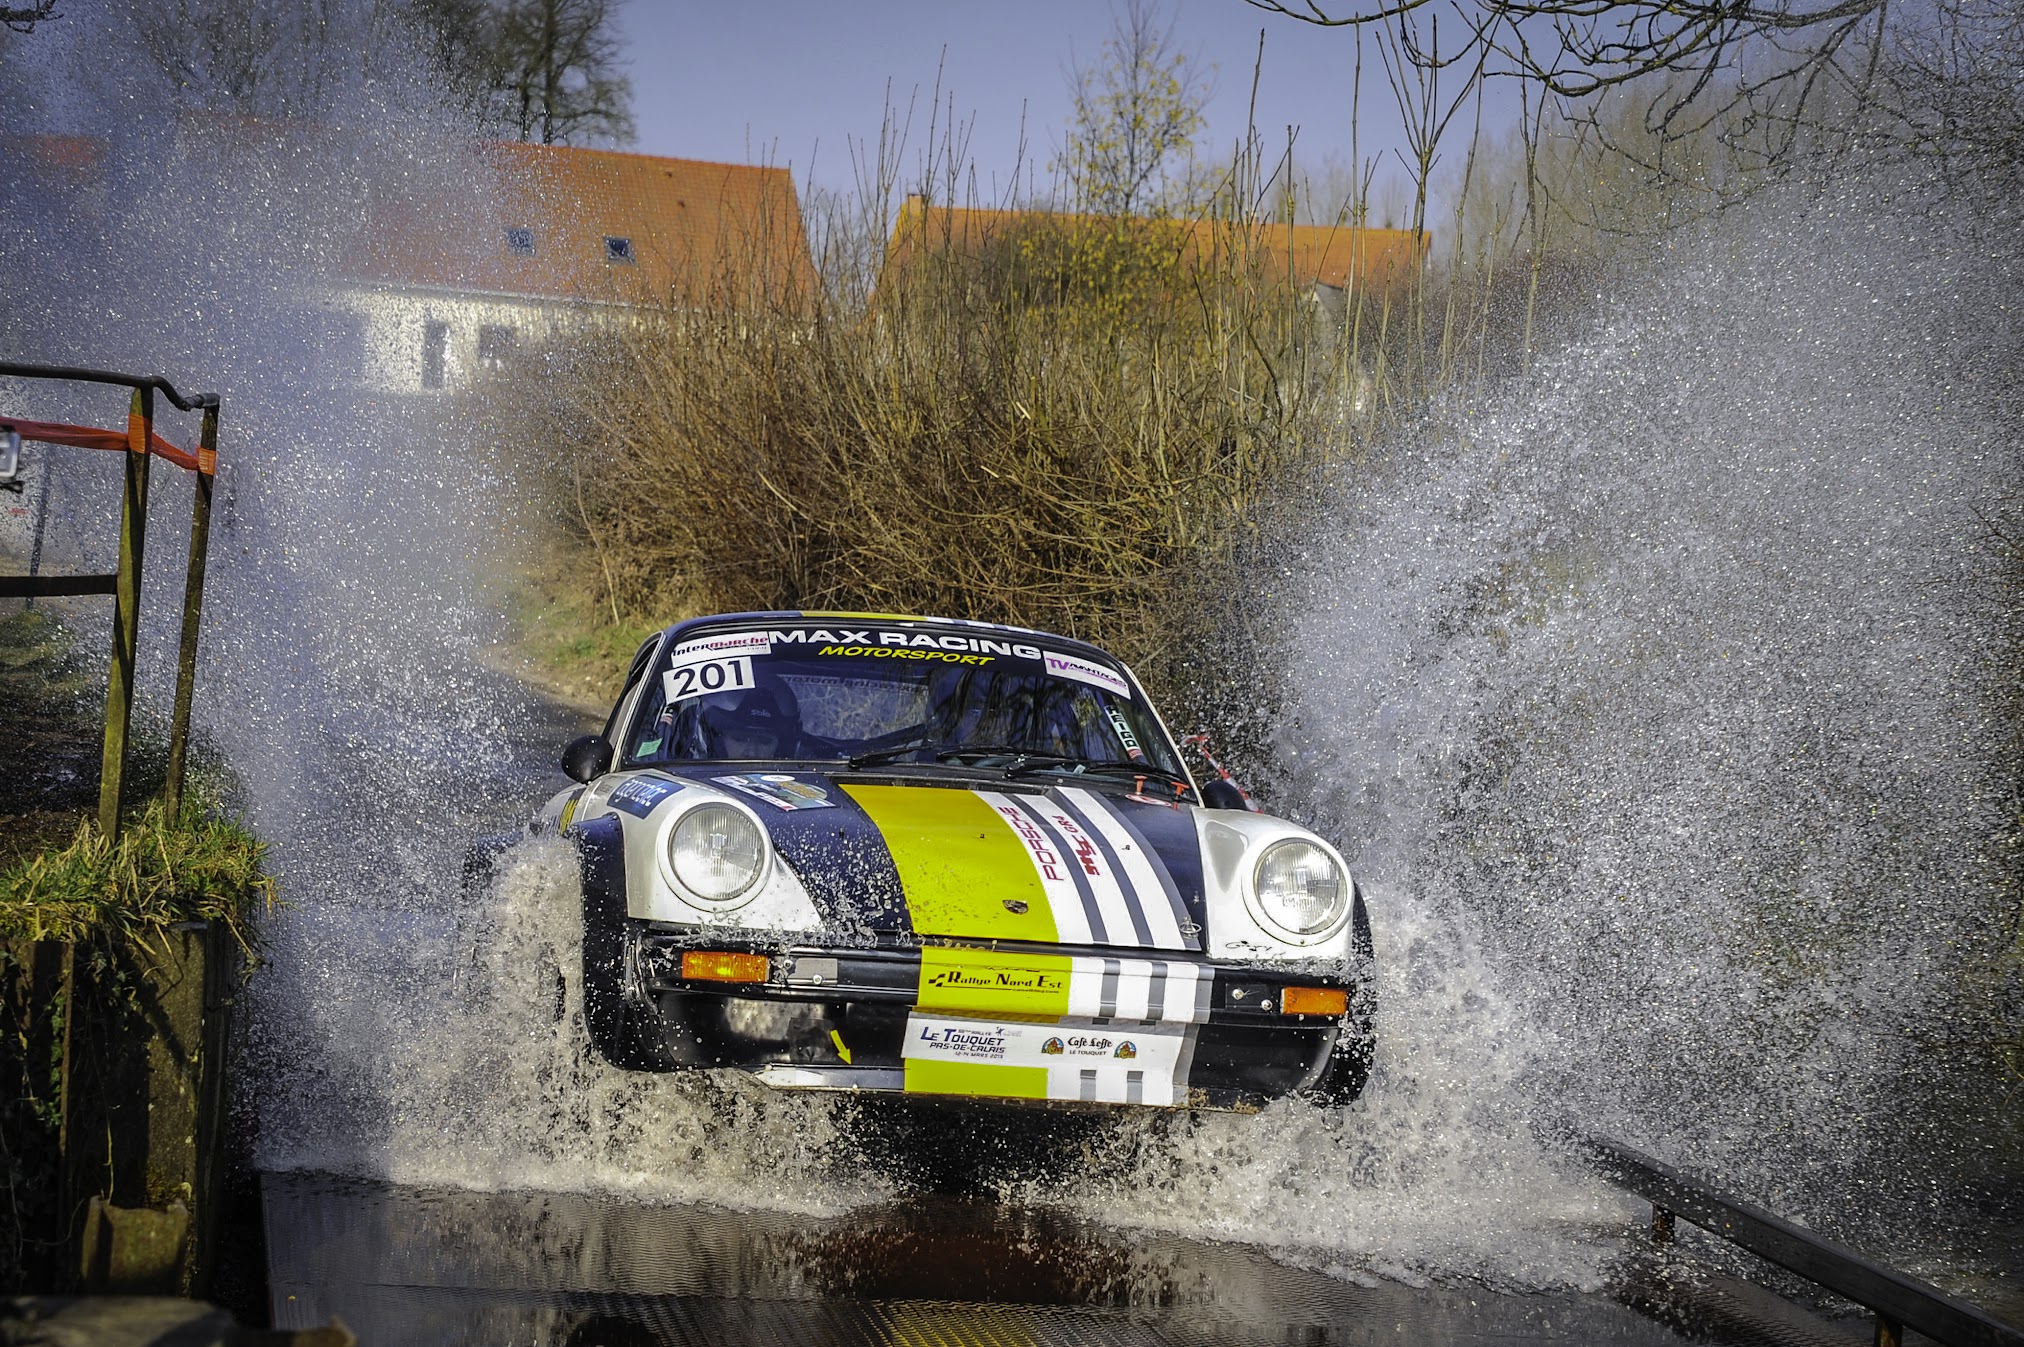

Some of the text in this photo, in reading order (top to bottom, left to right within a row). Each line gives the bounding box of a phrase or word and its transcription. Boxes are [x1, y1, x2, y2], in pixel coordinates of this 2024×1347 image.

[769, 630, 1042, 660] MAX RACING
[818, 646, 995, 665] MOTORSPORT
[1046, 658, 1069, 670] TV
[673, 660, 743, 698] 201
[998, 806, 1064, 881] PORSCHE
[947, 971, 1062, 988] Rallye Nord Est
[944, 1029, 1005, 1046] TOUQUET
[930, 1042, 1006, 1054] PAS-DE-CALAIS
